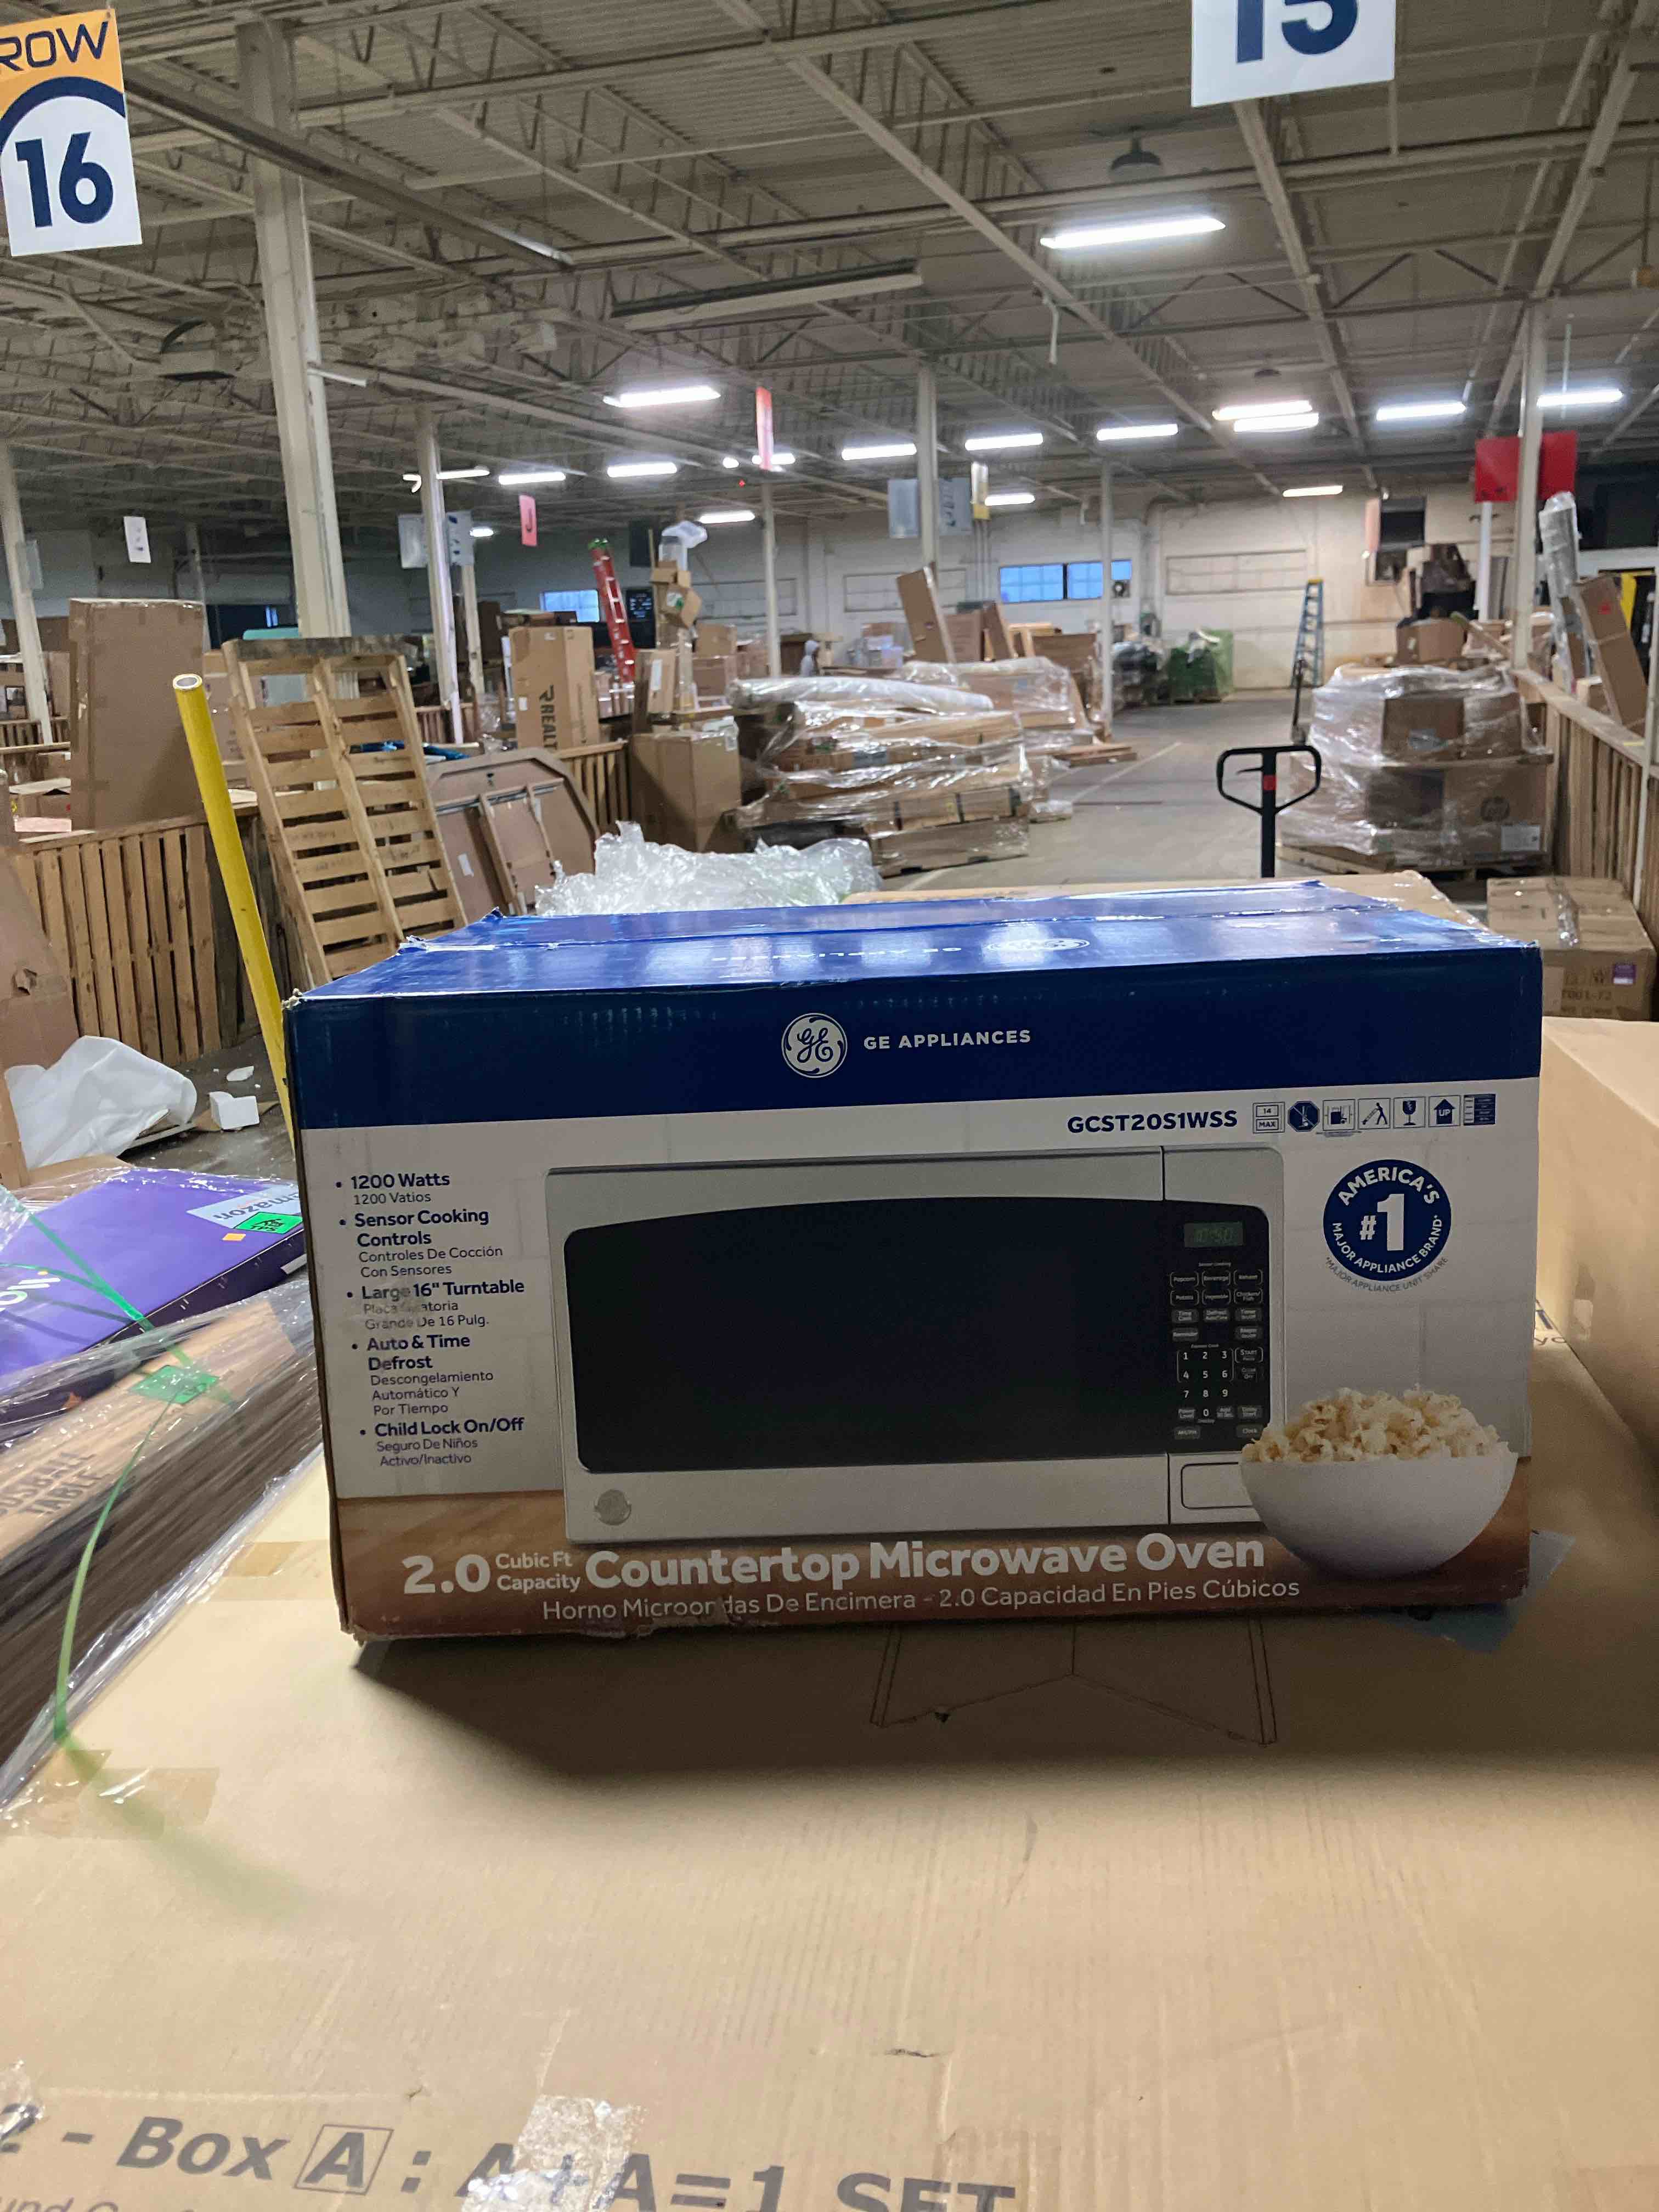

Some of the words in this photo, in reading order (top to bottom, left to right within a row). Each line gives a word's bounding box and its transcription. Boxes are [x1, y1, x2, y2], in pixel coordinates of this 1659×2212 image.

[0, 21, 108, 72] ROW
[15, 131, 114, 228] 16
[864, 1036, 890, 1050] GE
[898, 1029, 1031, 1049] APPLIANCES
[1438, 1108, 1451, 1118] UP
[1259, 1121, 1276, 1129] MAX
[351, 1173, 394, 1189] 1200
[398, 1172, 450, 1188] Watts
[1338, 1166, 1440, 1206] AMERICA'S
[354, 1193, 386, 1205] 1200
[389, 1192, 431, 1204] Vatios
[355, 1211, 414, 1228] Sensor
[417, 1208, 489, 1225] Cooking
[357, 1231, 432, 1248] Controls
[1332, 1222, 1356, 1261] MAJOR
[1354, 1254, 1421, 1273] APPLIANCE
[359, 1249, 424, 1263] Controles
[427, 1249, 446, 1260] De
[449, 1245, 503, 1259] Cocción
[360, 1266, 387, 1278] Con
[391, 1263, 453, 1277] Sensores
[413, 1282, 440, 1297] 16"
[443, 1279, 525, 1296] Turntable
[365, 1319, 414, 1330] Grande
[417, 1317, 436, 1327] De
[439, 1316, 455, 1327] 16
[458, 1314, 489, 1328] Pulg.
[366, 1336, 409, 1352] Auto
[411, 1334, 425, 1350] &
[426, 1334, 471, 1348] Time
[368, 1355, 433, 1372] Defrost
[1222, 1351, 1228, 1359] 3
[371, 1371, 494, 1387] Descongelamiento
[1203, 1370, 1209, 1379] 5
[1222, 1370, 1228, 1378] 6
[372, 1387, 449, 1401] Automático
[452, 1386, 460, 1397] Y
[1203, 1390, 1209, 1398] 8
[1222, 1389, 1229, 1397] 9
[374, 1404, 396, 1416] Por
[398, 1403, 449, 1415] Tiempo
[375, 1421, 418, 1438] Child
[421, 1419, 461, 1435] Lock
[464, 1417, 525, 1434] On/Off
[377, 1440, 421, 1454] Seguro
[423, 1438, 441, 1450] De
[443, 1437, 478, 1449] Niños
[380, 1453, 472, 1467] Activo/Inactivo
[495, 1551, 550, 1570] Cubic
[552, 1551, 573, 1568] Ft
[584, 1547, 860, 1590] Countertop
[870, 1539, 1128, 1580] Microwave
[1135, 1532, 1265, 1571] Oven
[402, 1553, 492, 1595] 2.0
[496, 1573, 582, 1594] Capacity
[543, 1600, 616, 1621] Horno
[766, 1593, 799, 1612] De
[805, 1590, 916, 1613] Encimera
[939, 1587, 975, 1608] 2.0
[981, 1583, 1105, 1608] Capacidad
[1112, 1583, 1141, 1602] En
[1148, 1581, 1196, 1600] Pies
[1203, 1577, 1300, 1600] Cúbicos
[116, 2115, 289, 2180] Box
[303, 2131, 365, 2188] A
